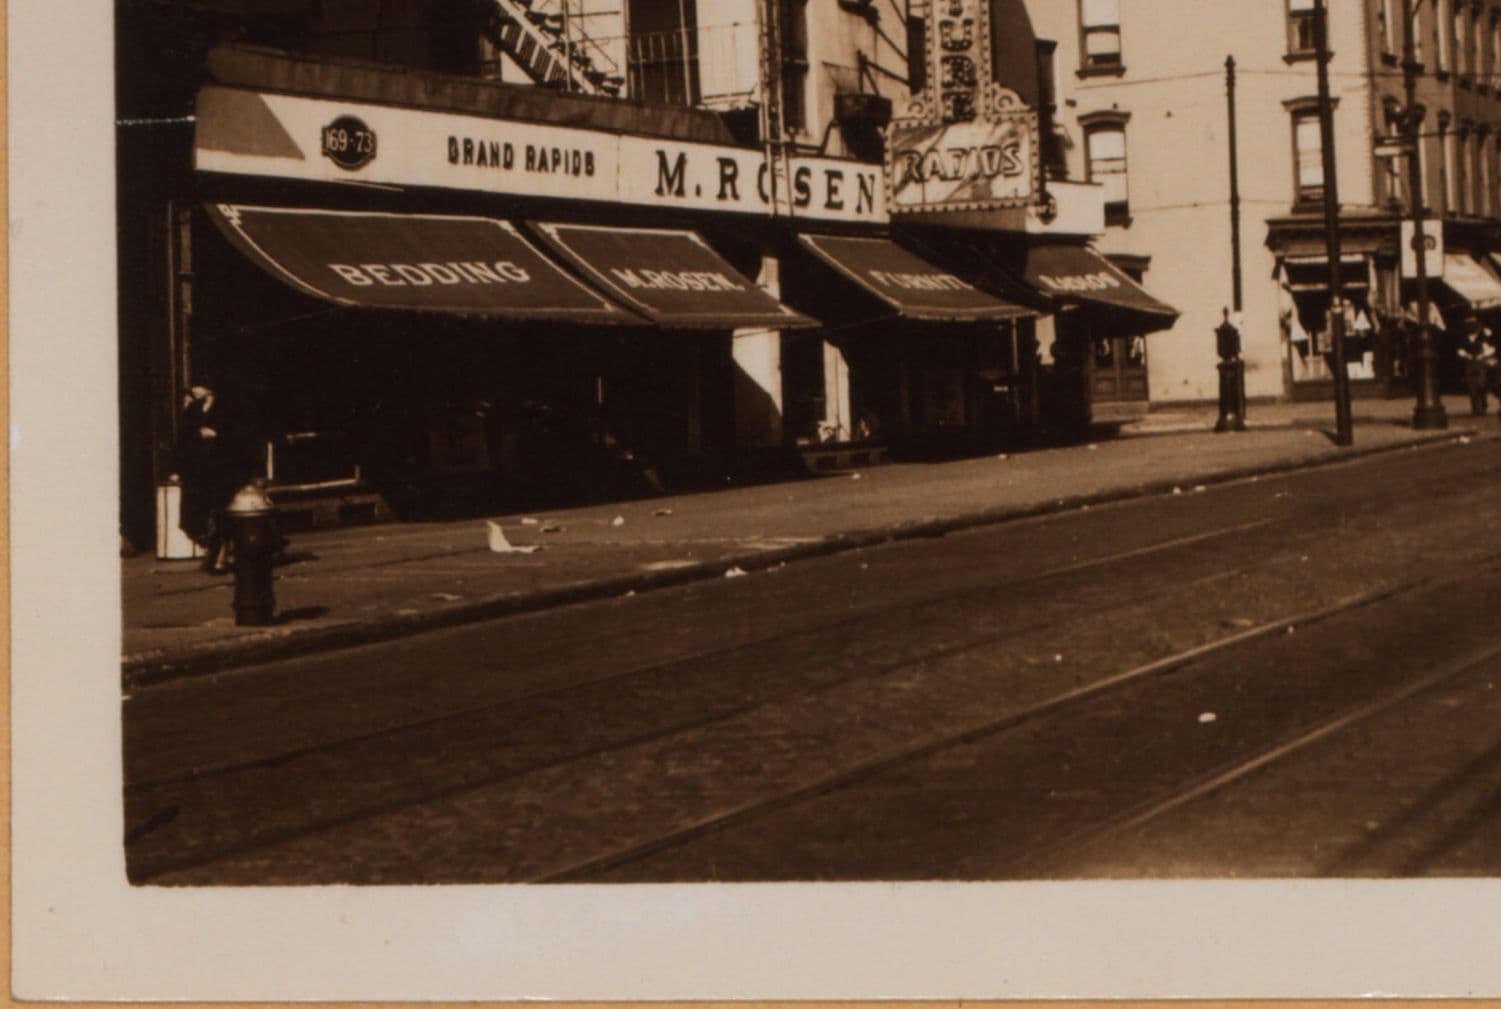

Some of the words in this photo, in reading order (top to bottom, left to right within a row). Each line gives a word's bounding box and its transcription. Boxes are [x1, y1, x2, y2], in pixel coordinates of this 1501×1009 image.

[448, 136, 515, 171] GRAND
[900, 143, 1024, 184] RADIOS
[327, 260, 531, 287] BEDDING
